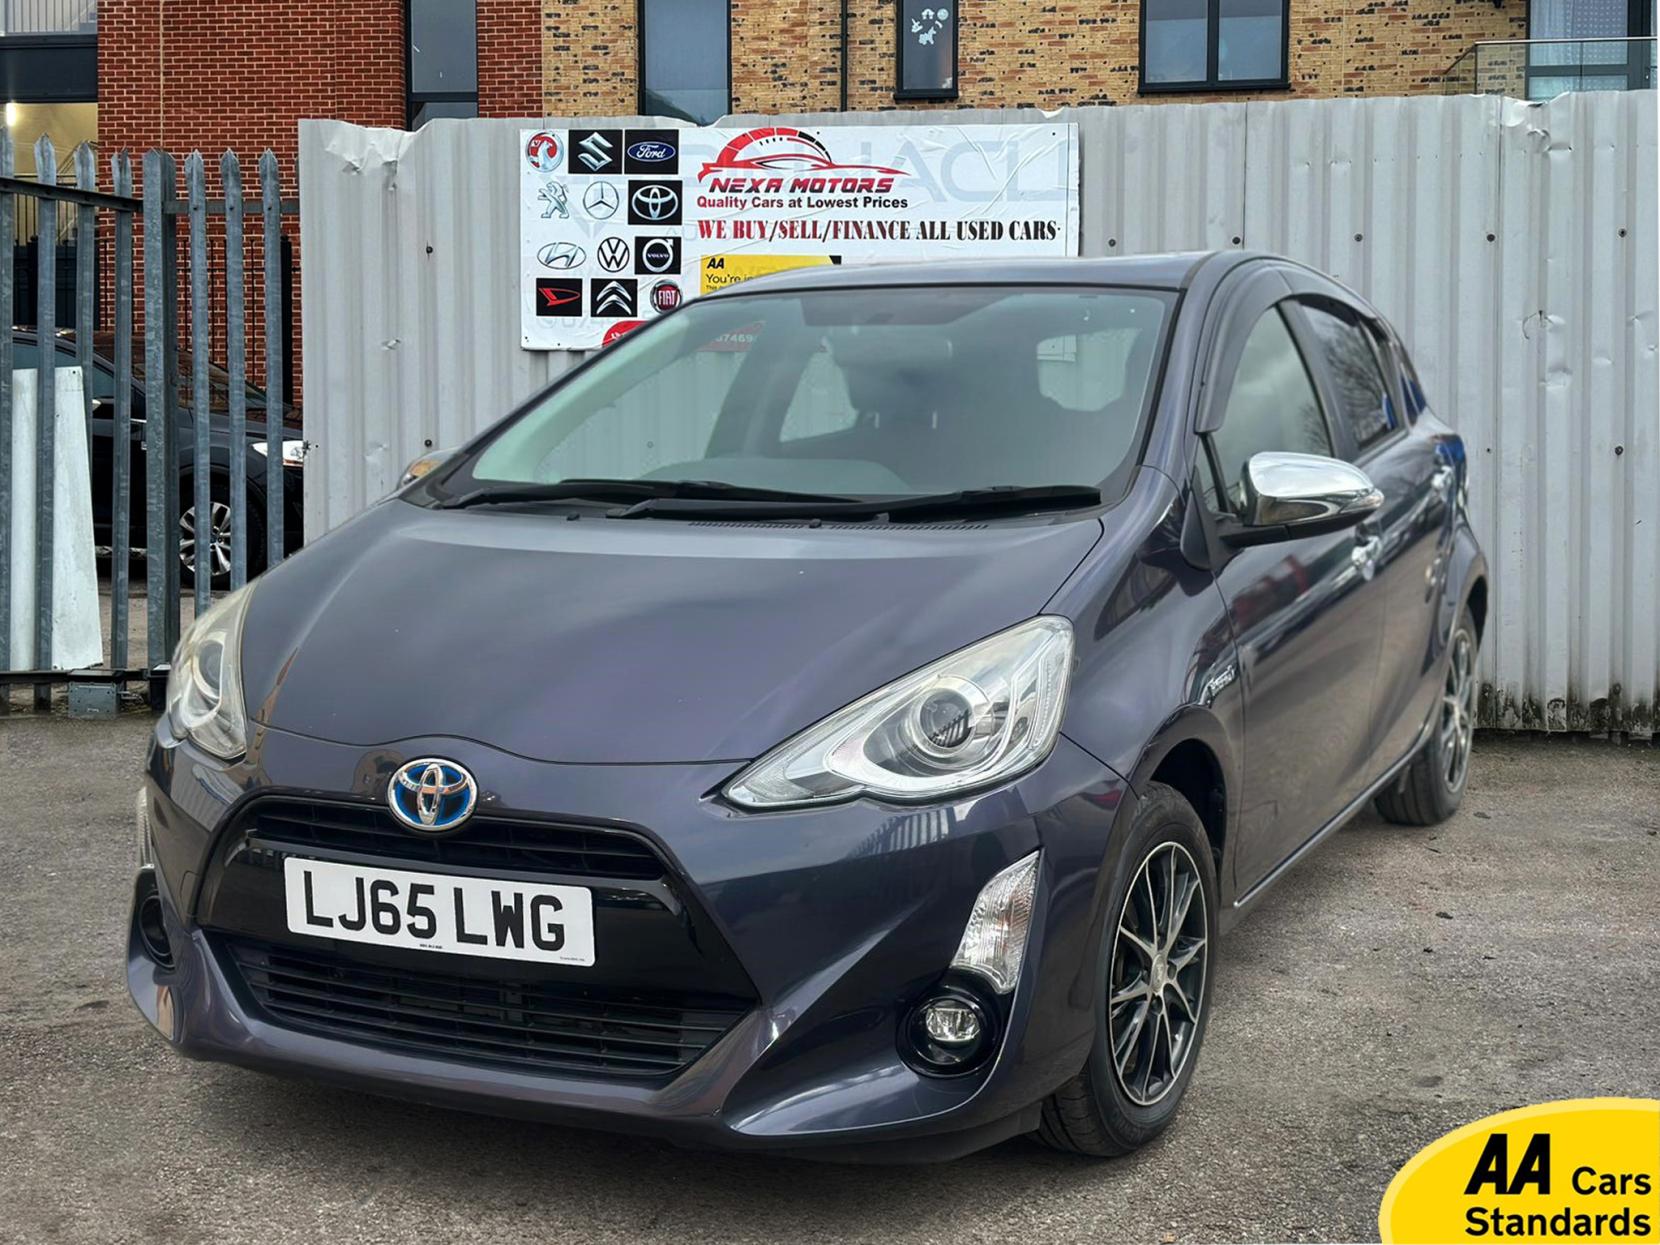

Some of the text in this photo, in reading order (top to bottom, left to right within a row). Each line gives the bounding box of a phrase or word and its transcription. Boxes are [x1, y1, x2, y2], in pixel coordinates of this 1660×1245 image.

[636, 144, 665, 158] Ford
[708, 177, 895, 194] NEXA MOTORS
[696, 196, 908, 210] Quality Cars at Lowest Prices
[697, 220, 727, 240] WE
[916, 220, 951, 241] ALL
[956, 220, 1004, 241] USED
[1008, 220, 1057, 241] CARS
[706, 257, 725, 269] AA
[658, 289, 676, 306] FIAT
[303, 870, 565, 951] LJ65 LWG
